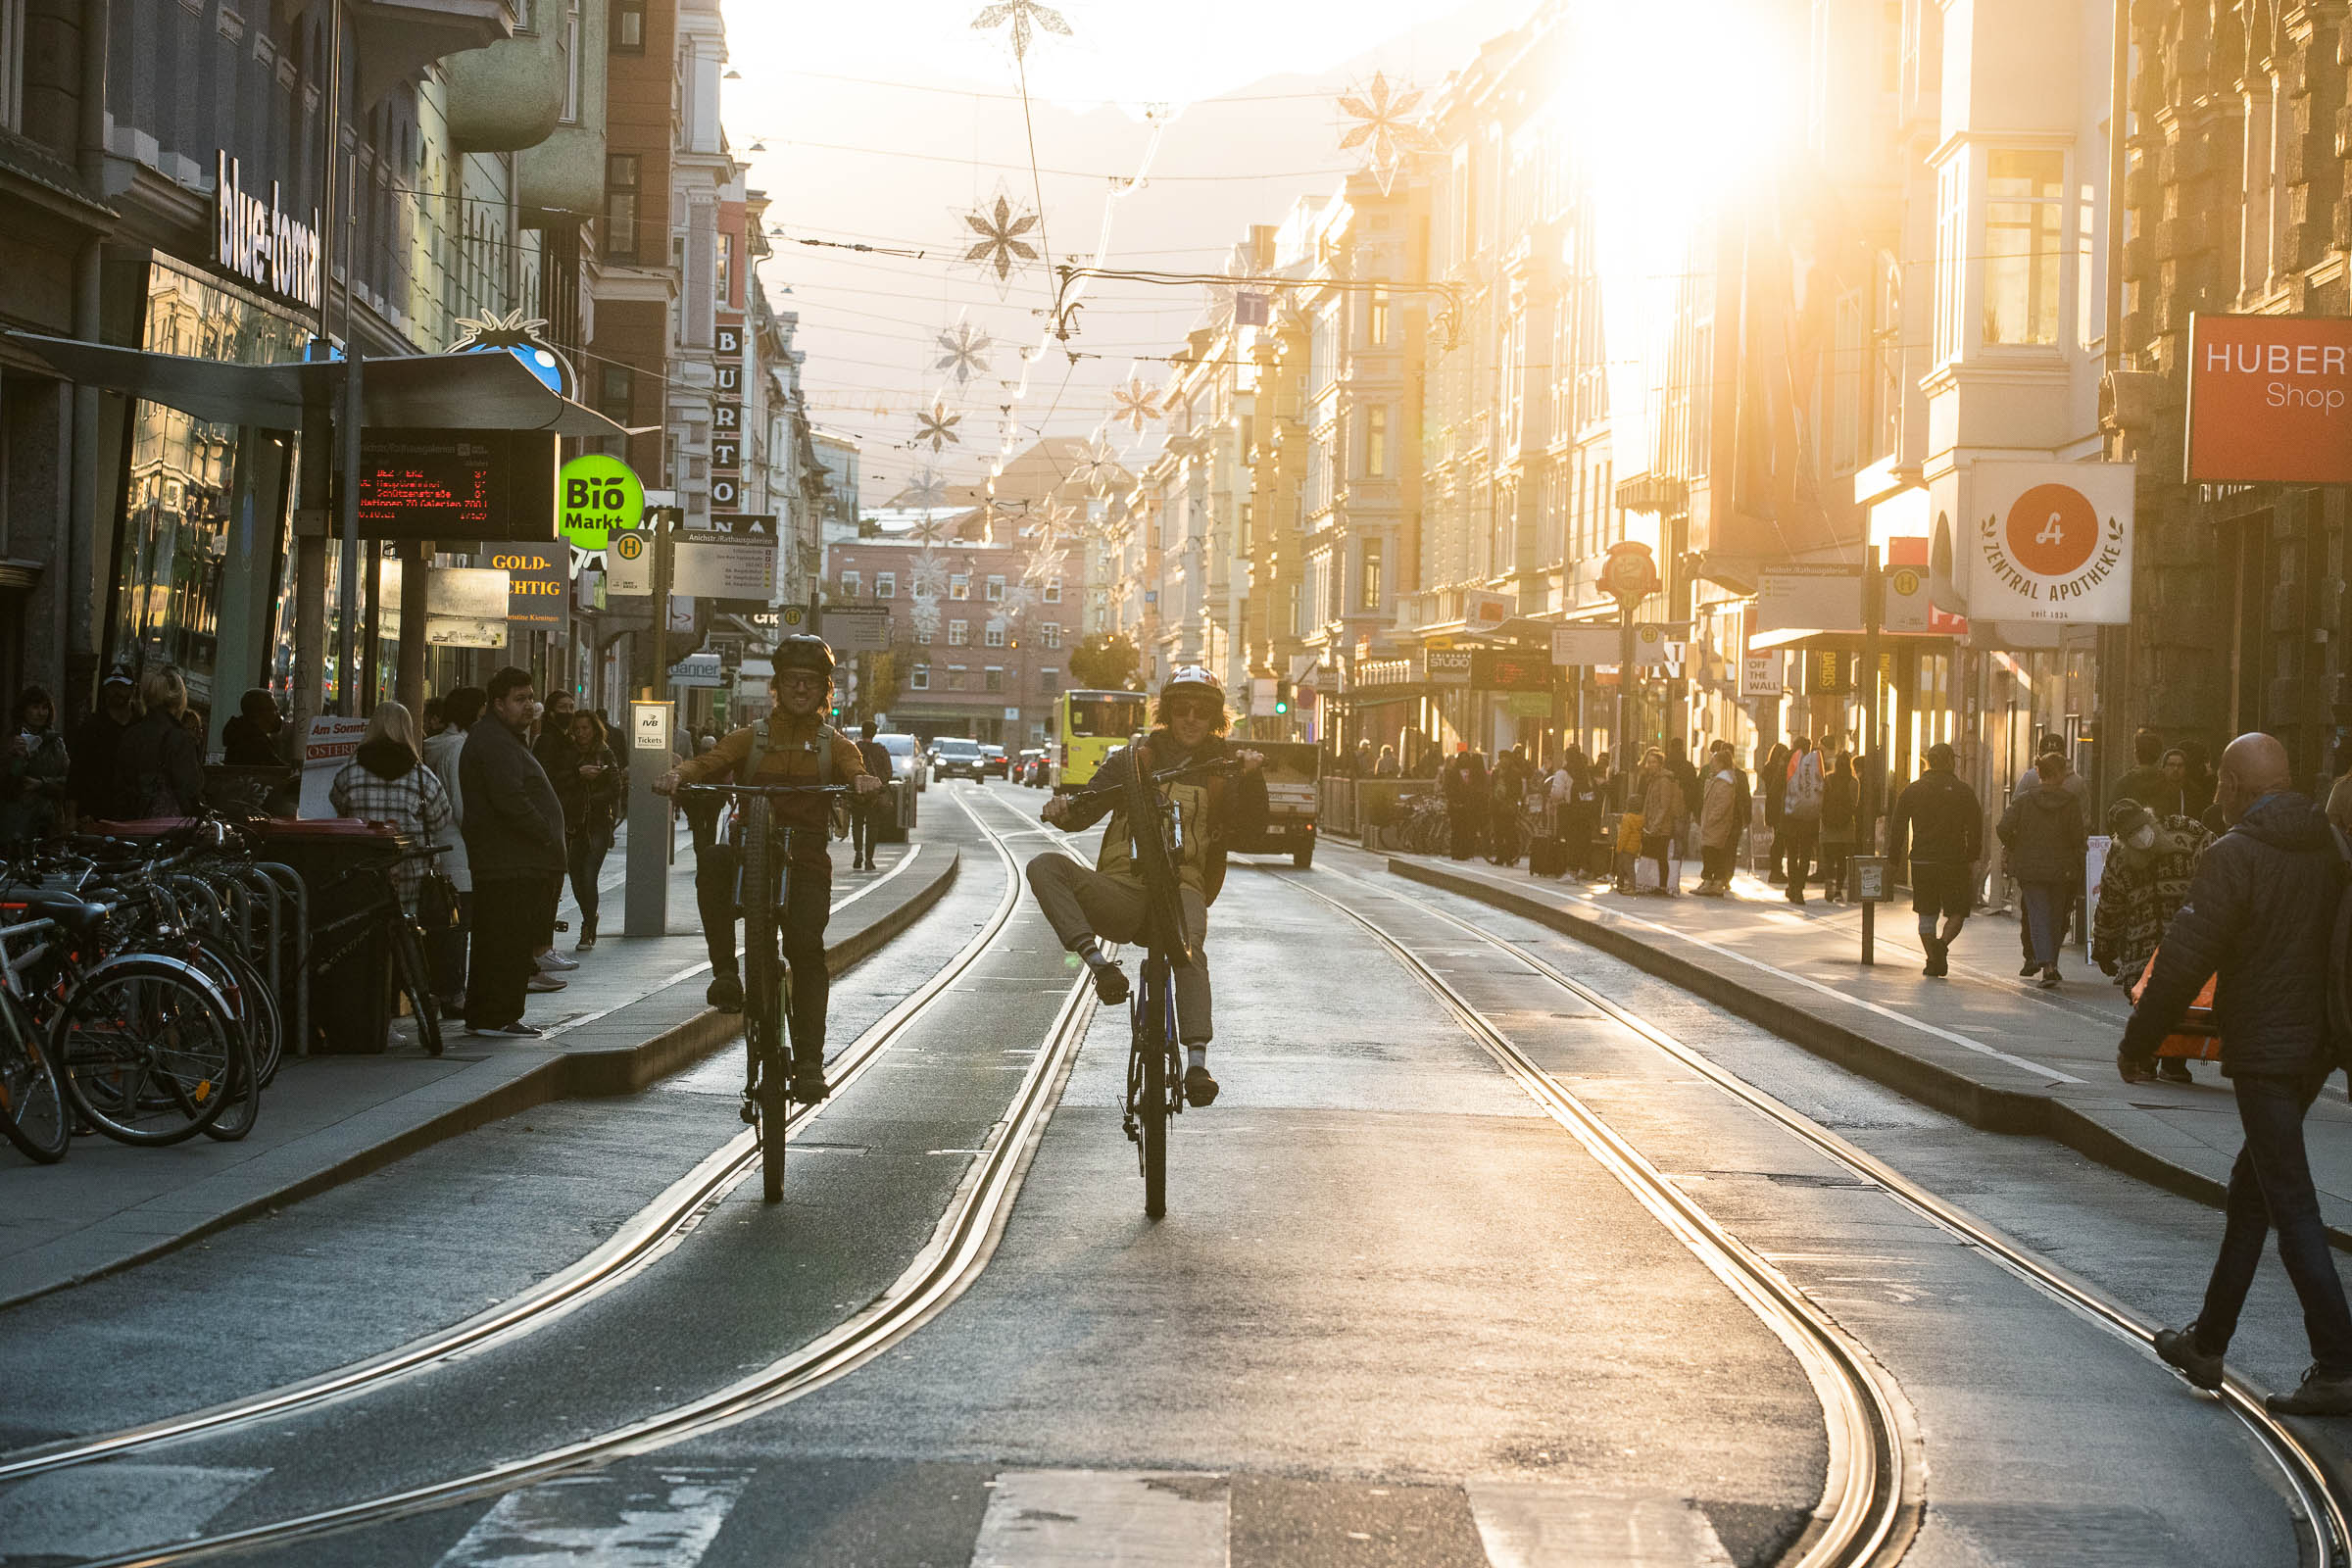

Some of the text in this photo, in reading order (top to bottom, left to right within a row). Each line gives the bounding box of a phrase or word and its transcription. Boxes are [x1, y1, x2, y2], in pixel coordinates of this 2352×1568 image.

[217, 149, 320, 312] blue-tomat
[2207, 343, 2345, 374] HUBER
[2266, 382, 2345, 416] Shop
[565, 513, 623, 529] Markt
[492, 555, 552, 570] GOLD-
[1983, 542, 2121, 602] ZENTRAL APOTHEKE
[1749, 670, 1768, 680] THE
[313, 721, 367, 735] Am Sonnt
